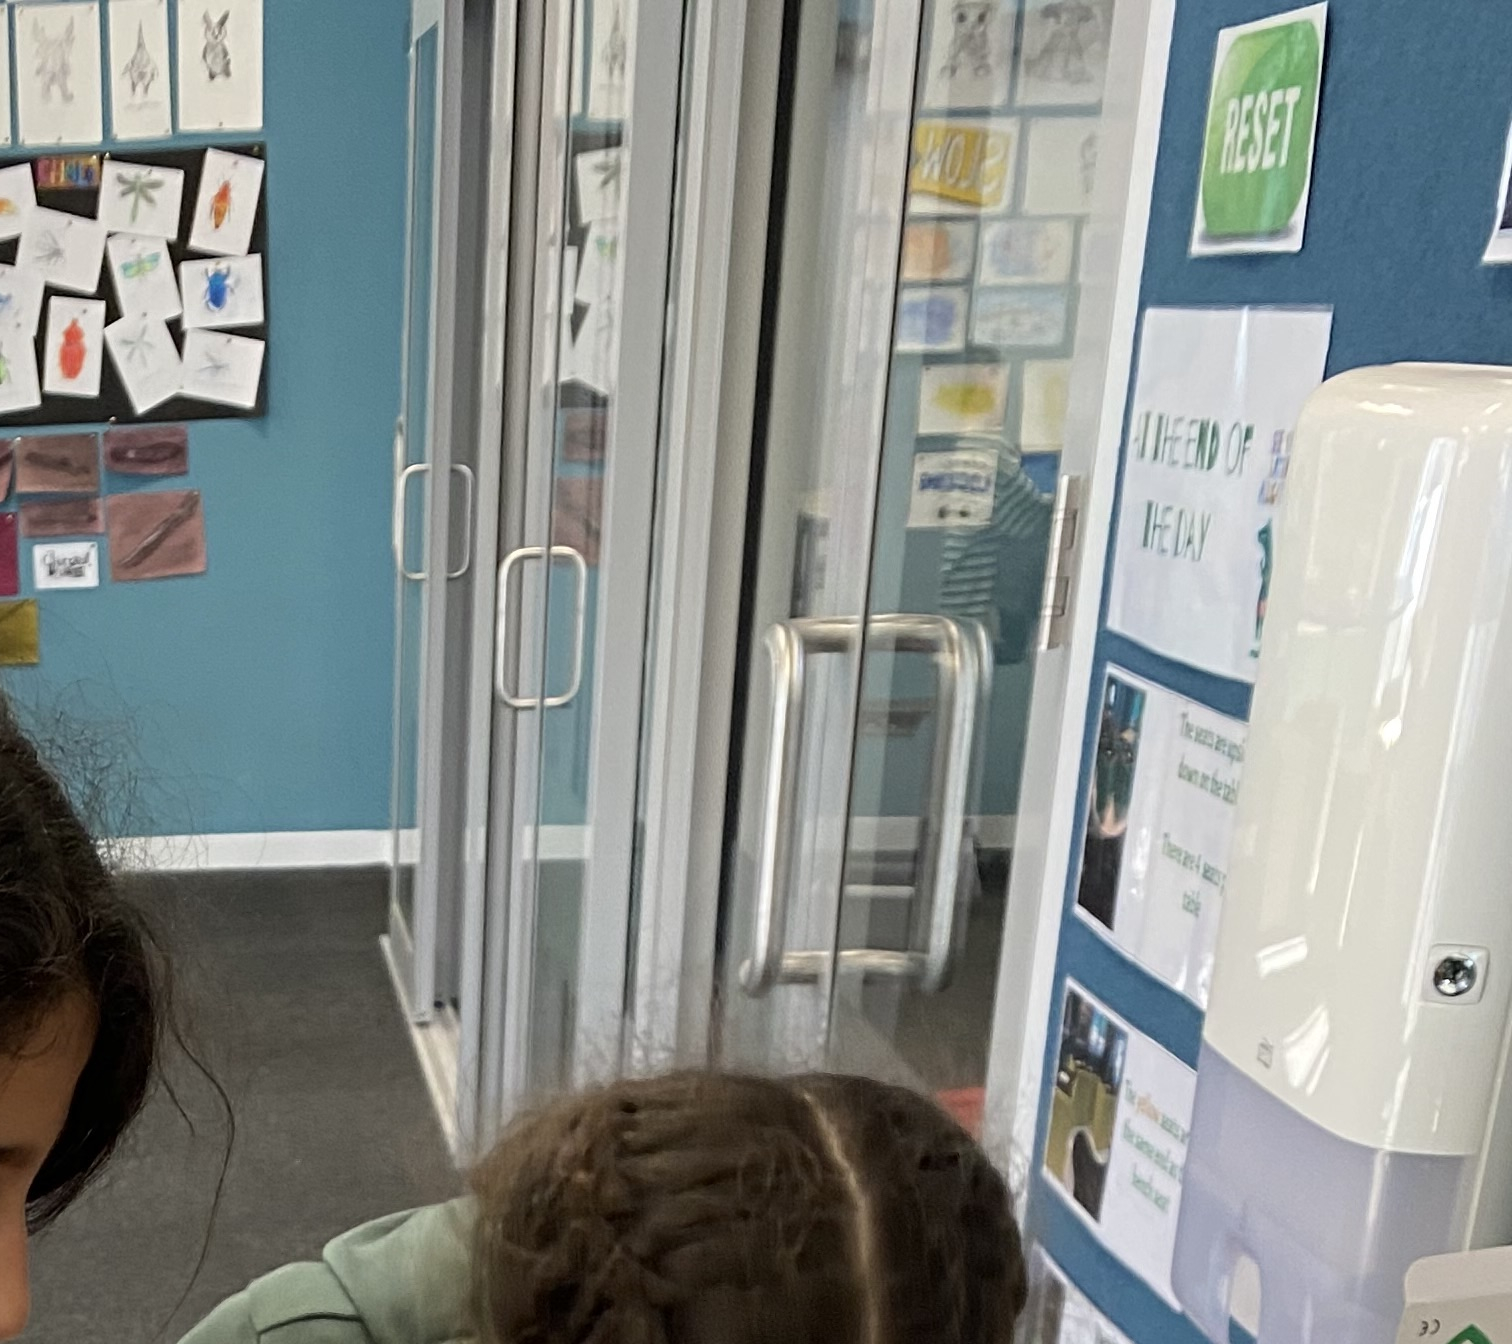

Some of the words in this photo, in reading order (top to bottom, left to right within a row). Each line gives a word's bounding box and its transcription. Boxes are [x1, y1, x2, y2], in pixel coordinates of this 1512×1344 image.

[1221, 85, 1301, 174] RESET
[1183, 418, 1220, 472] END
[1225, 421, 1255, 478] OF
[1142, 500, 1173, 556] THE
[1173, 508, 1211, 562] DAY
